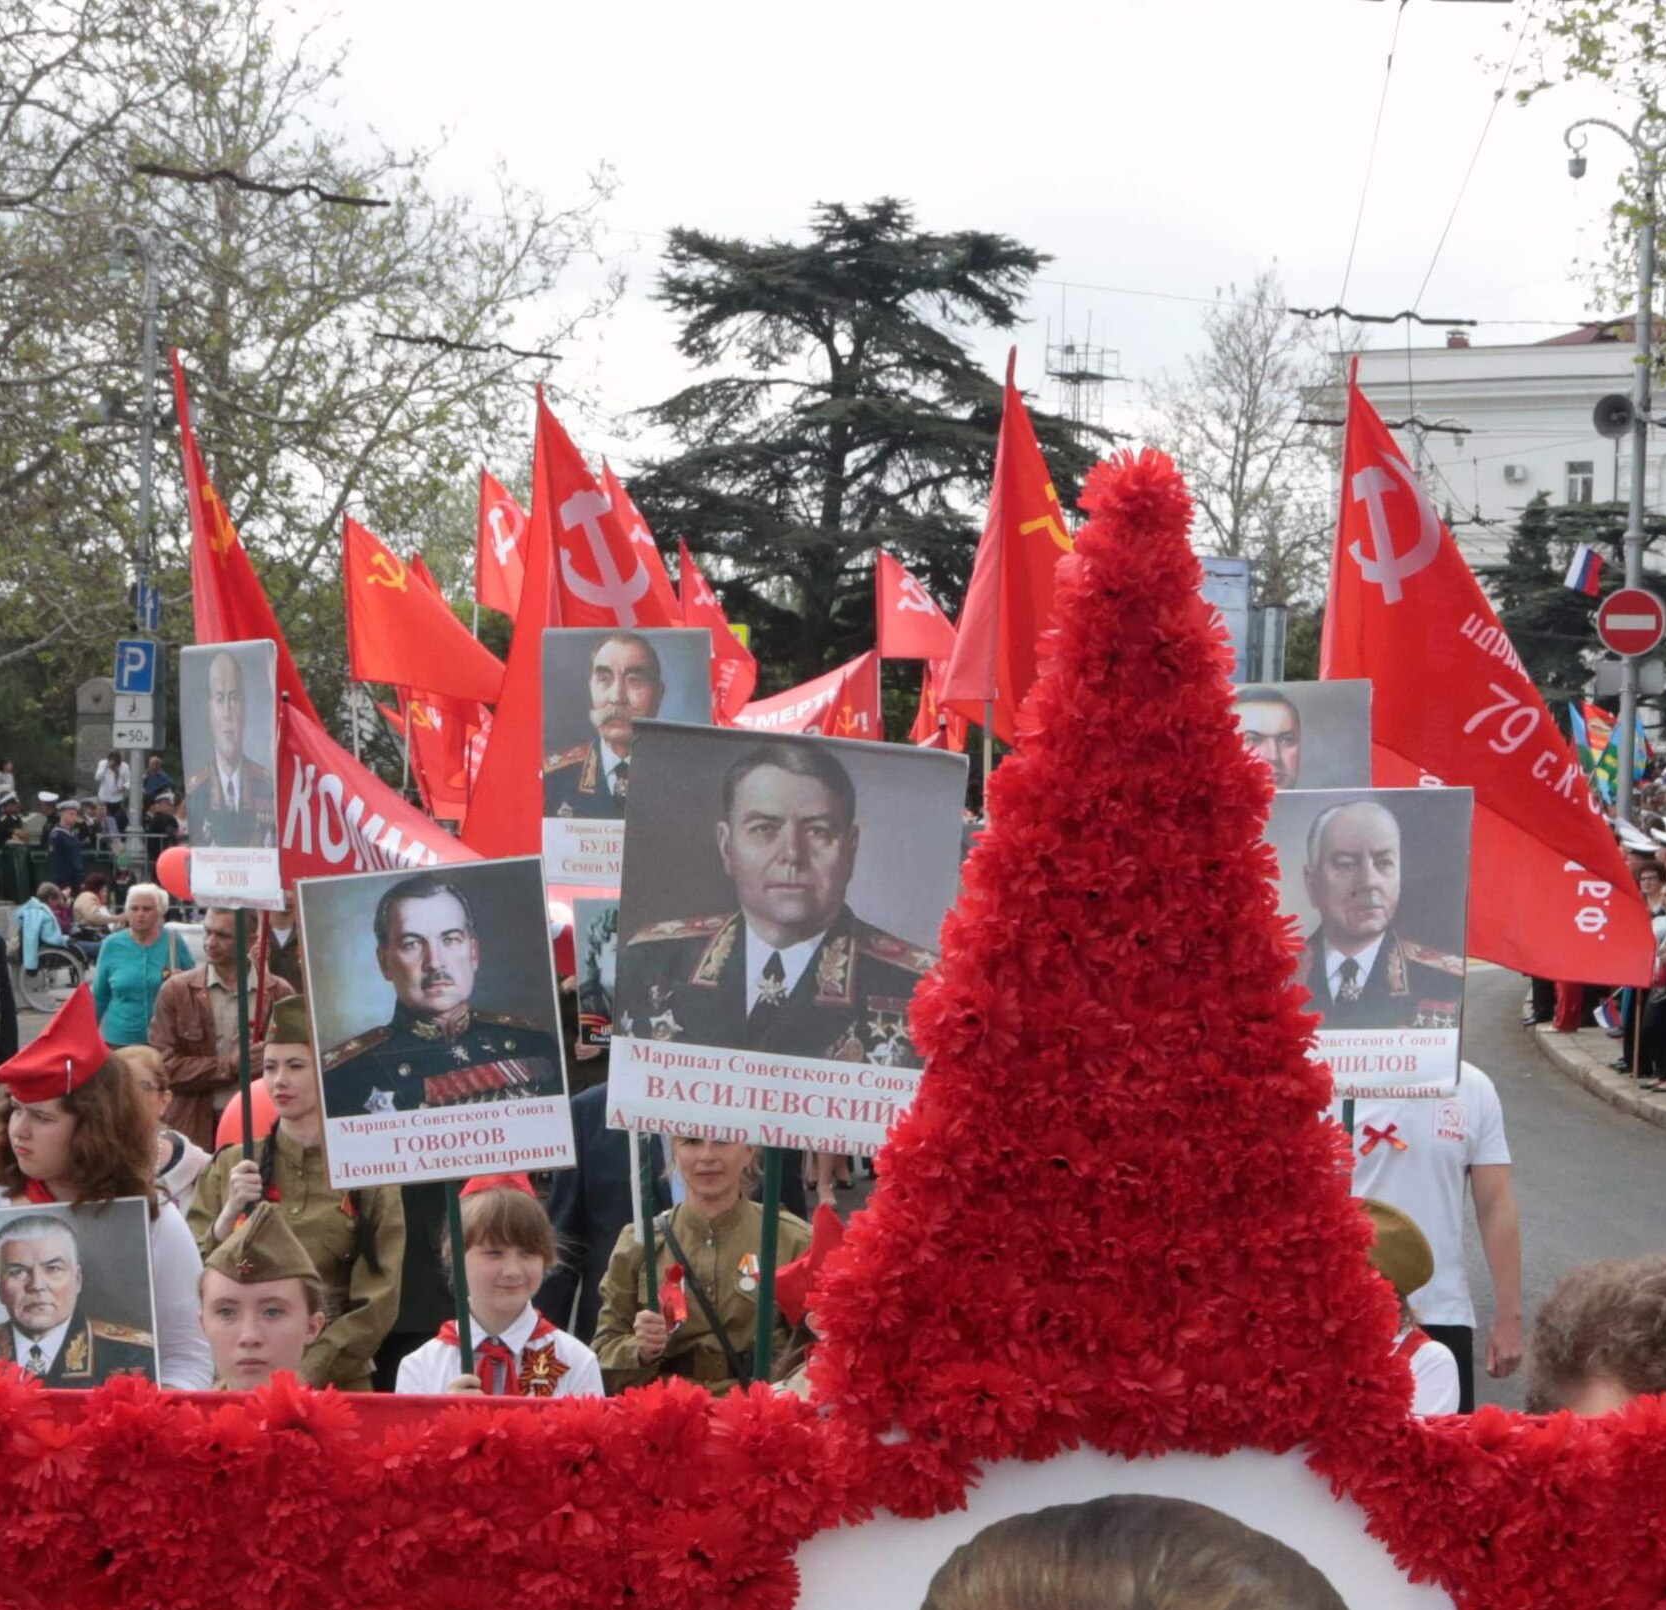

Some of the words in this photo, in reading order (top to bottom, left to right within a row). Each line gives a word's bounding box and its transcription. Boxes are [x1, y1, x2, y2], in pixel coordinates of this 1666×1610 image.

[123, 646, 146, 688] P
[1463, 682, 1540, 753] 79
[580, 839, 621, 855] БУДЕ
[562, 859, 603, 873] Семен
[1320, 1036, 1394, 1048] оветского
[1399, 1034, 1446, 1046] Союза
[630, 1043, 721, 1071] Маршал
[728, 1056, 850, 1086] Советского
[1314, 1055, 1417, 1072] ШИЛОВ
[646, 1075, 896, 1125] ВАСИЛЕВСКИЙ
[340, 1119, 406, 1136] Маршал
[411, 1108, 500, 1128] Советского
[504, 1103, 554, 1117] Союза
[609, 1108, 749, 1145] Александр
[759, 1125, 879, 1157] Михайло
[393, 1127, 505, 1155] ГОВОРОВ
[335, 1160, 408, 1180] Леонид
[414, 1144, 567, 1172] Александрович
